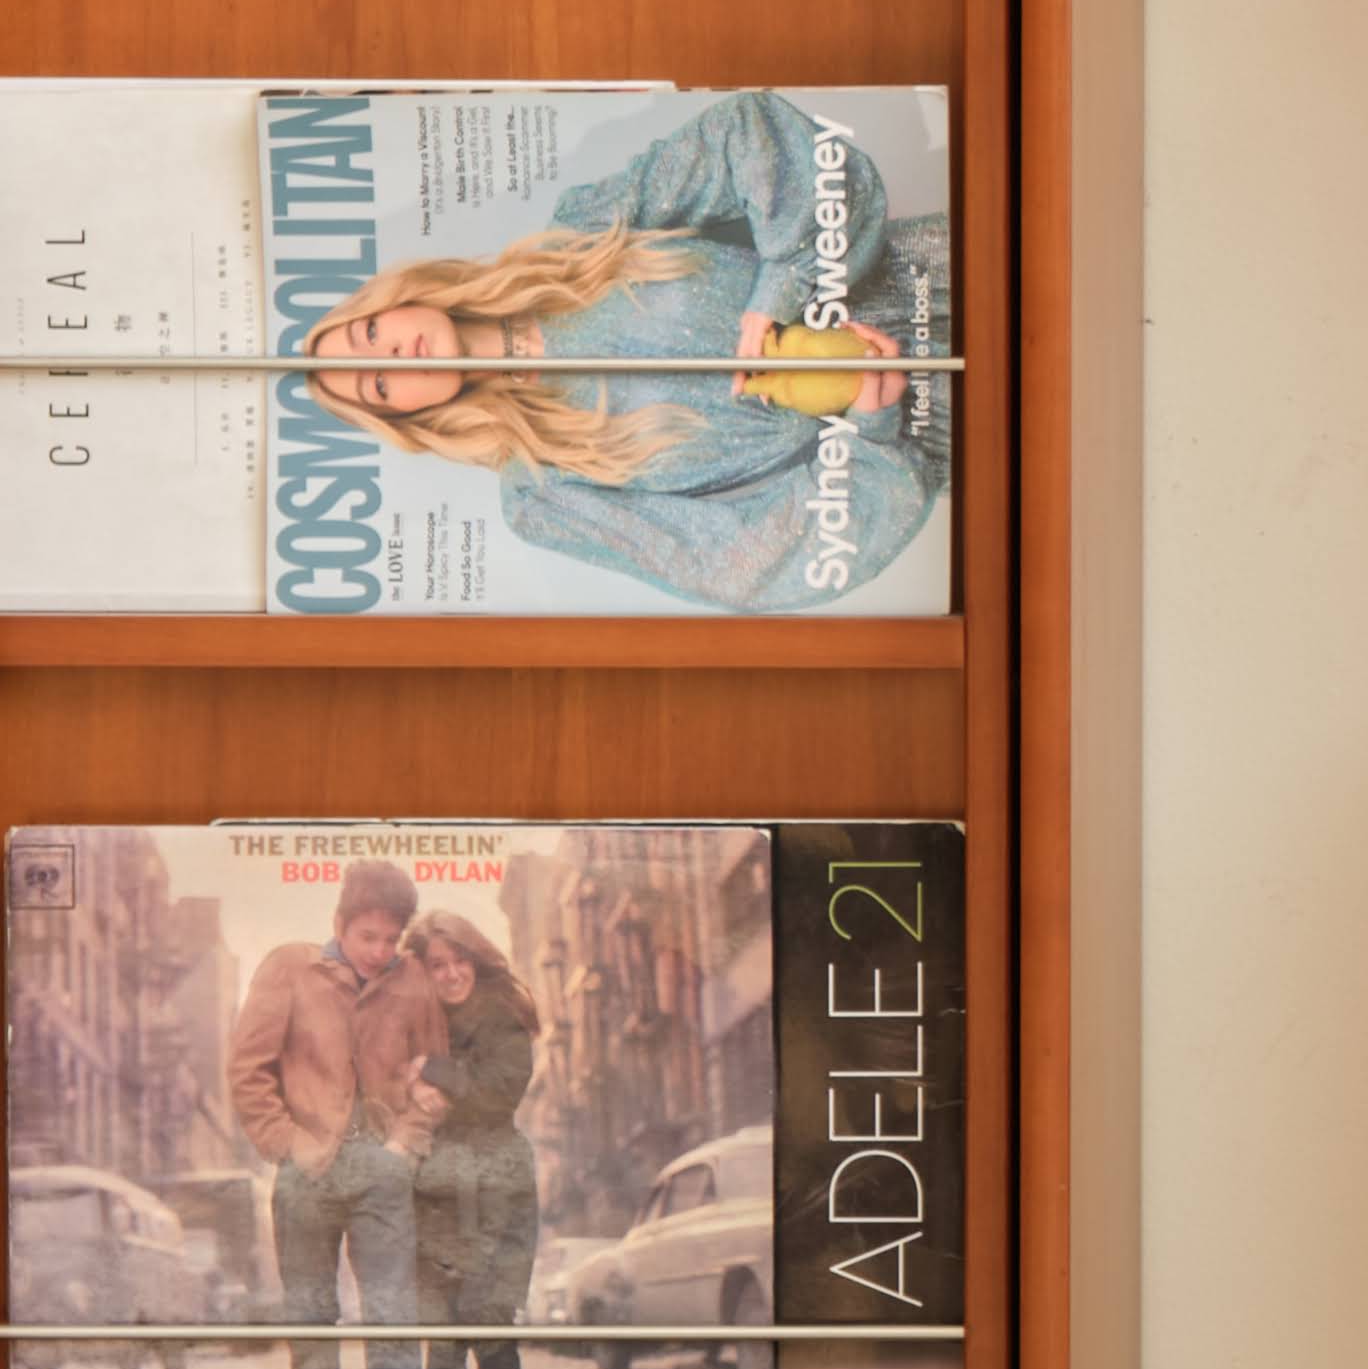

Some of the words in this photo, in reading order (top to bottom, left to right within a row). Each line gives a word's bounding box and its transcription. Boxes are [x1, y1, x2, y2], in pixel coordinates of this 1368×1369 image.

[416, 105, 428, 151] Viscount
[454, 106, 465, 146] Control
[455, 147, 466, 174] Birth
[506, 133, 517, 162] Least
[419, 162, 430, 195] Marry
[507, 164, 517, 176] at
[456, 175, 466, 203] Male
[507, 178, 518, 192] So
[420, 198, 430, 209] to
[420, 211, 431, 237] How
[803, 113, 854, 331] Sweeney
[44, 229, 90, 467] CEEAL
[914, 326, 930, 342] a
[909, 380, 930, 417] feel
[803, 415, 859, 592] Sydney
[425, 512, 436, 573] Horoscope
[460, 521, 471, 553] Good
[387, 538, 404, 583] LOVE
[460, 555, 472, 570] So
[425, 576, 435, 599] Your
[460, 572, 471, 601] Food
[228, 834, 284, 857] THE
[293, 834, 503, 857] FREEWHEELIN'
[281, 861, 341, 883] BOB
[413, 861, 503, 883] DYLAN
[828, 861, 923, 943] 21
[828, 961, 923, 1308] ADELE
